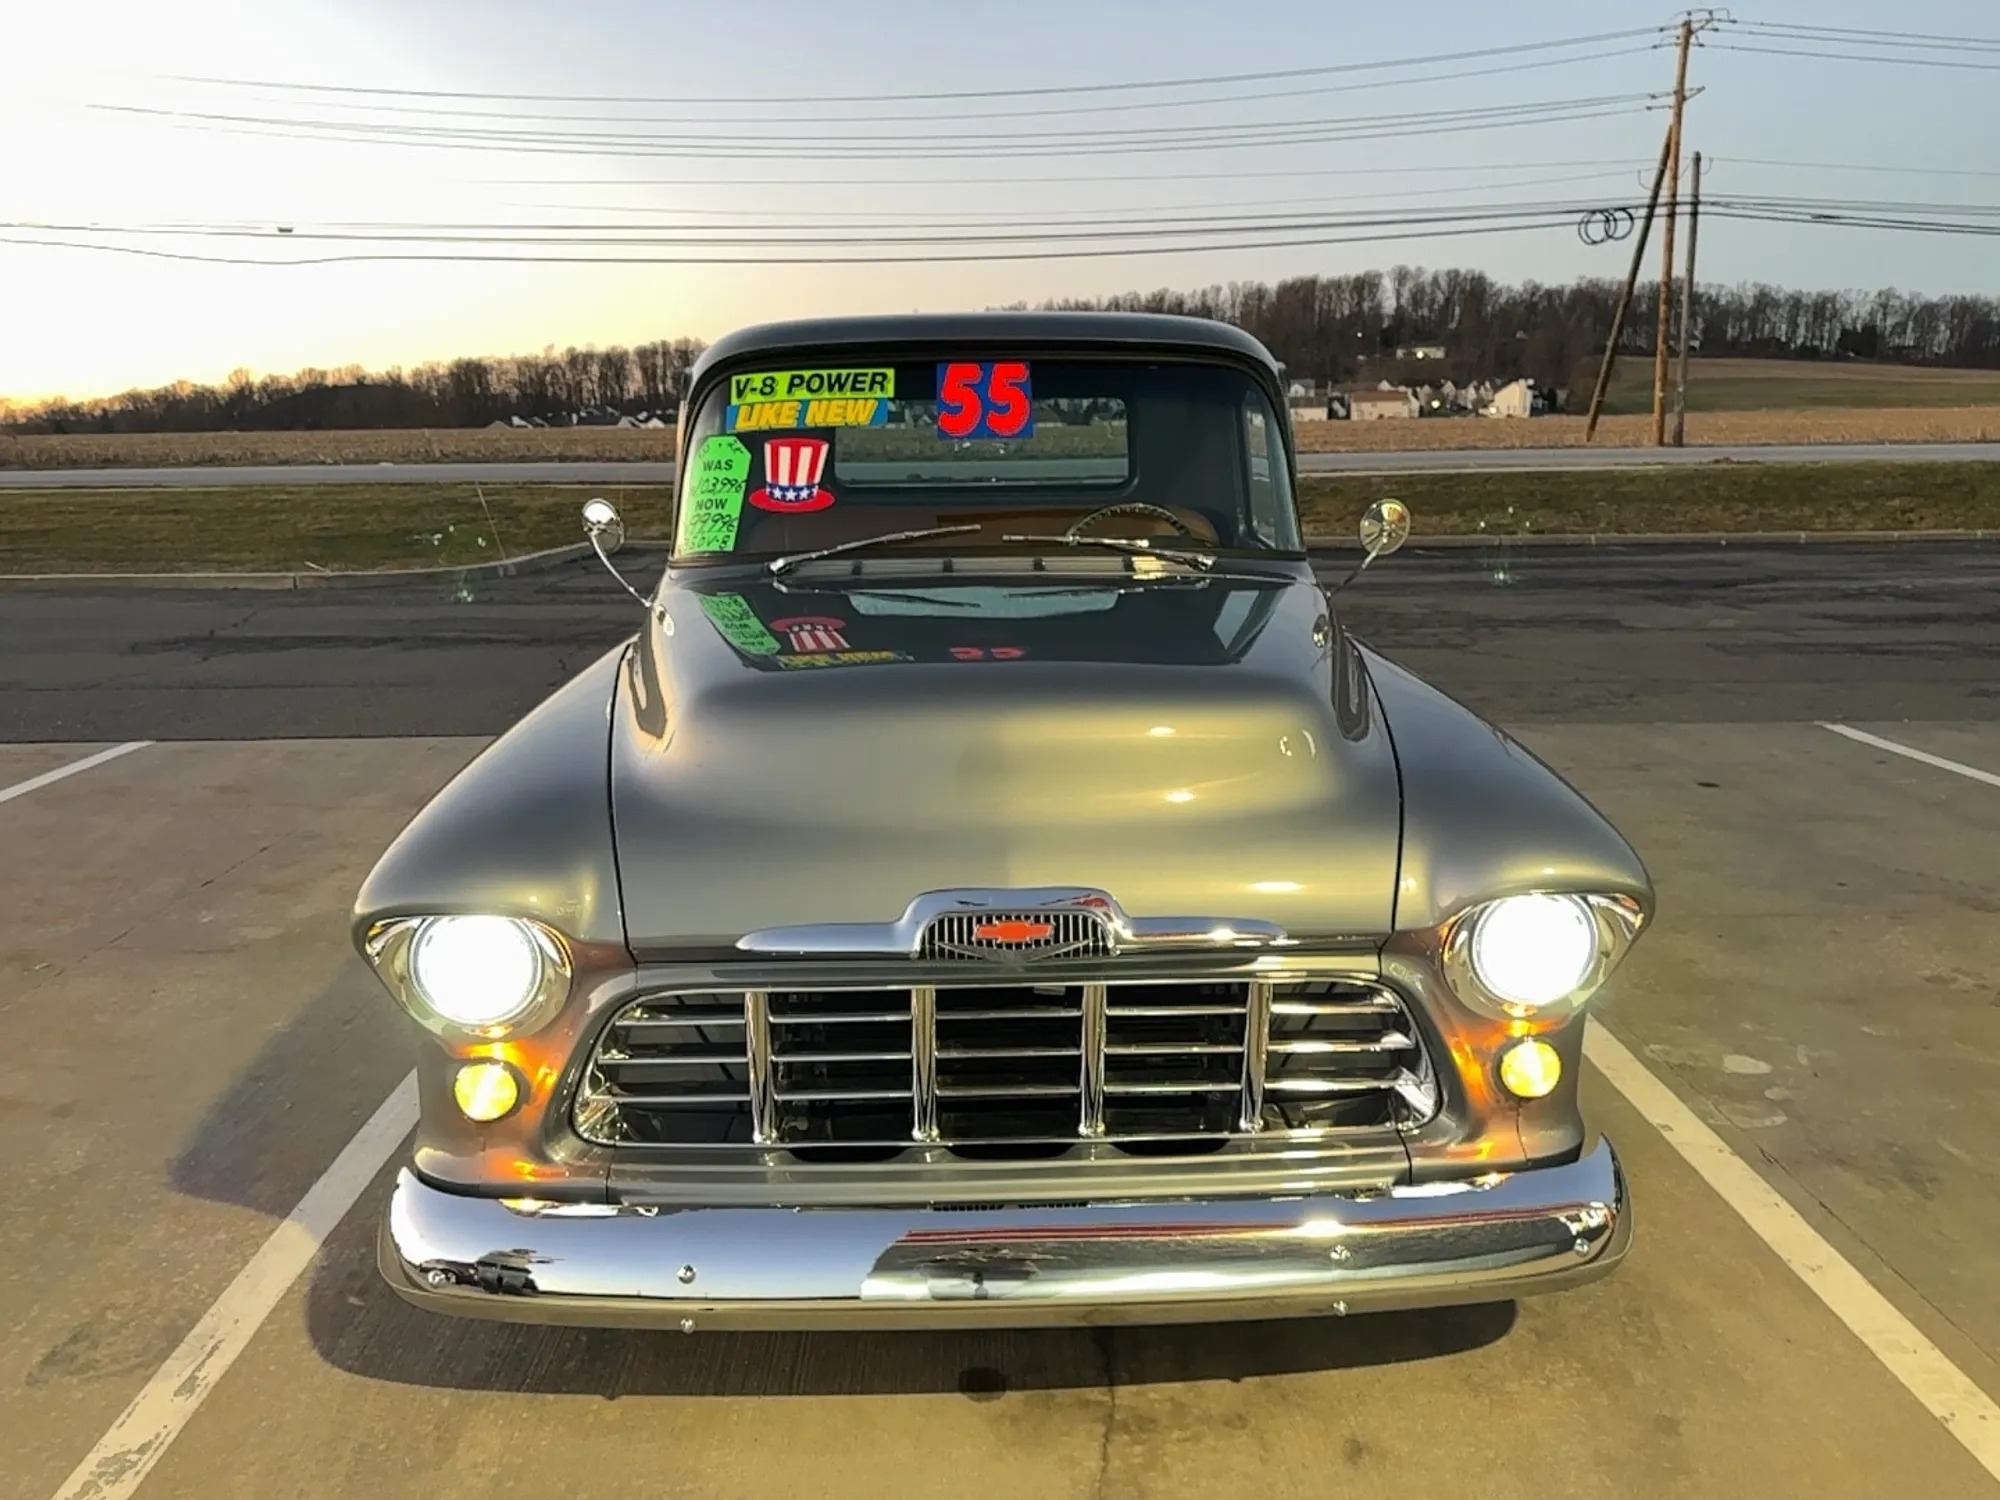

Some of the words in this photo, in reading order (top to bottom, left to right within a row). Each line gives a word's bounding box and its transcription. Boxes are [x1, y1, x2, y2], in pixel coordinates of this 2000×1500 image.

[735, 376, 776, 399] V-8
[786, 371, 889, 396] POWER
[938, 362, 1031, 437] 55
[735, 401, 802, 431] LIKE
[805, 399, 878, 427] NEW
[702, 458, 734, 472] WAS
[695, 497, 729, 512] NOW
